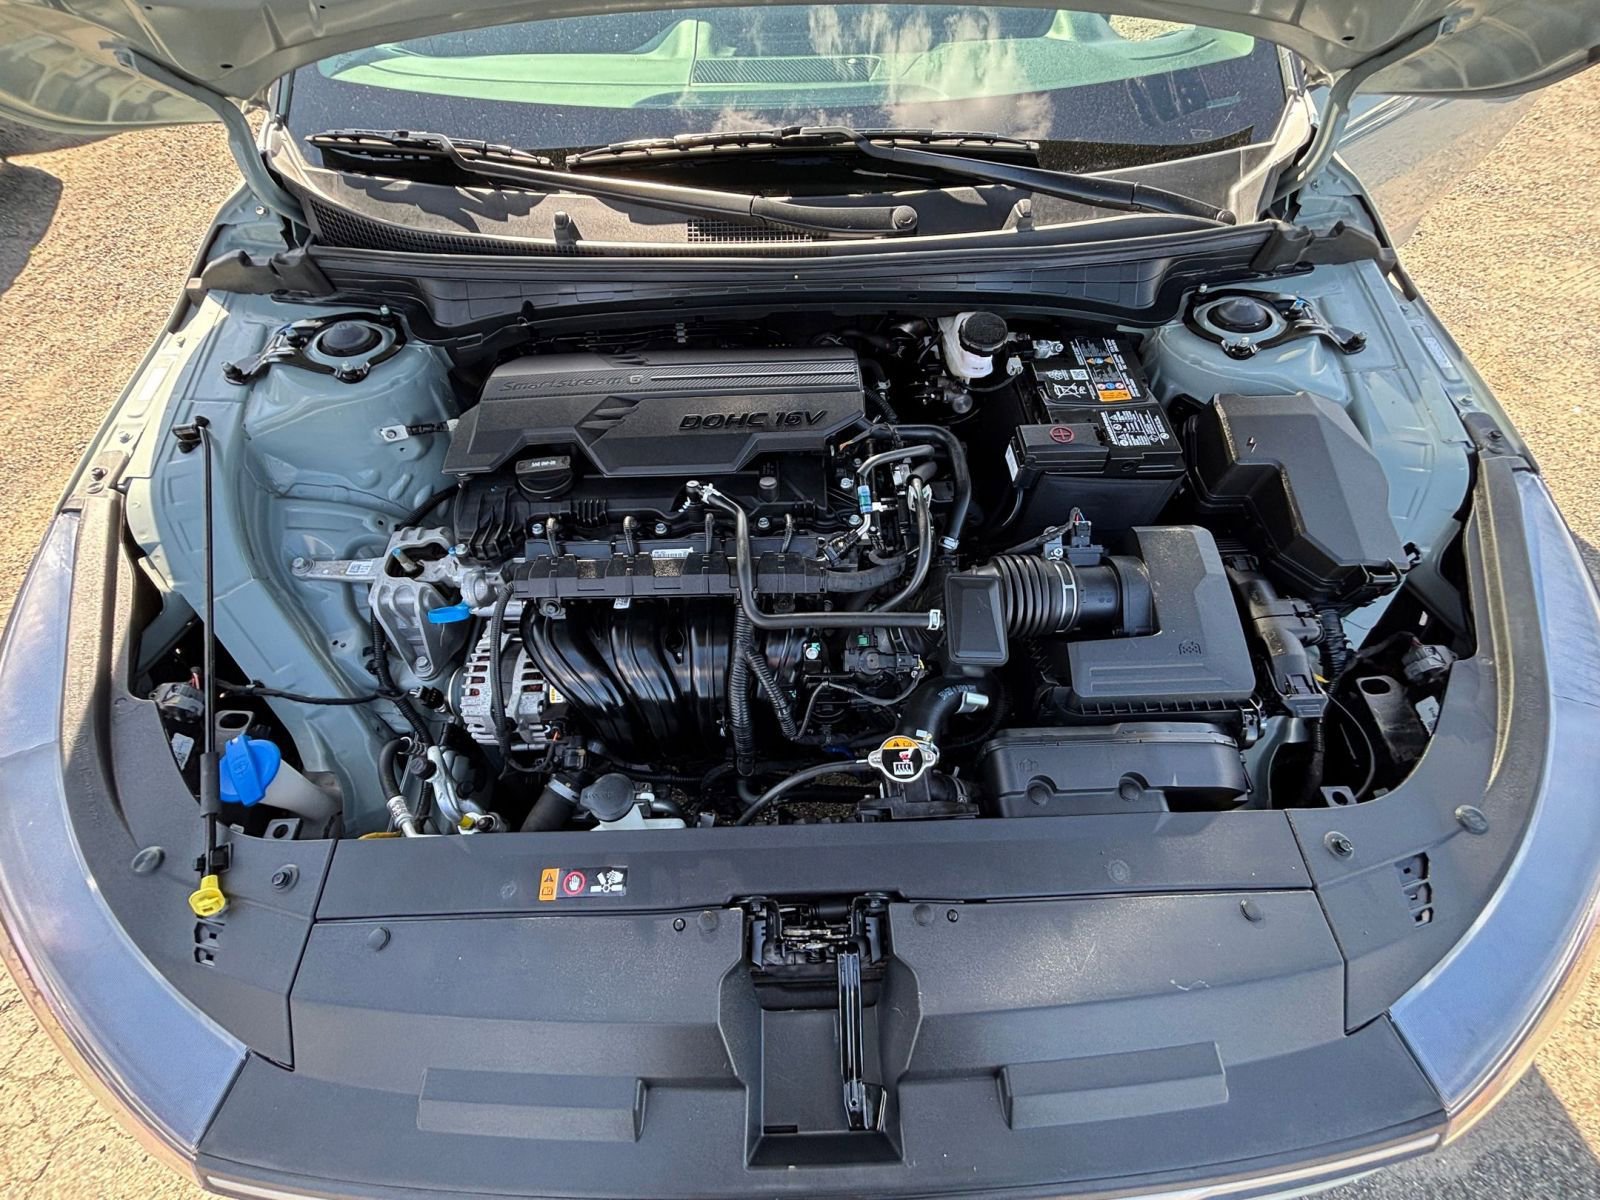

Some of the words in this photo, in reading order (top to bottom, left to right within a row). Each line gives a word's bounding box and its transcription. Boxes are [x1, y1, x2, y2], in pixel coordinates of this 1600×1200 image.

[628, 373, 644, 385] G
[678, 411, 769, 430] DOHC
[775, 409, 829, 428] 16V
